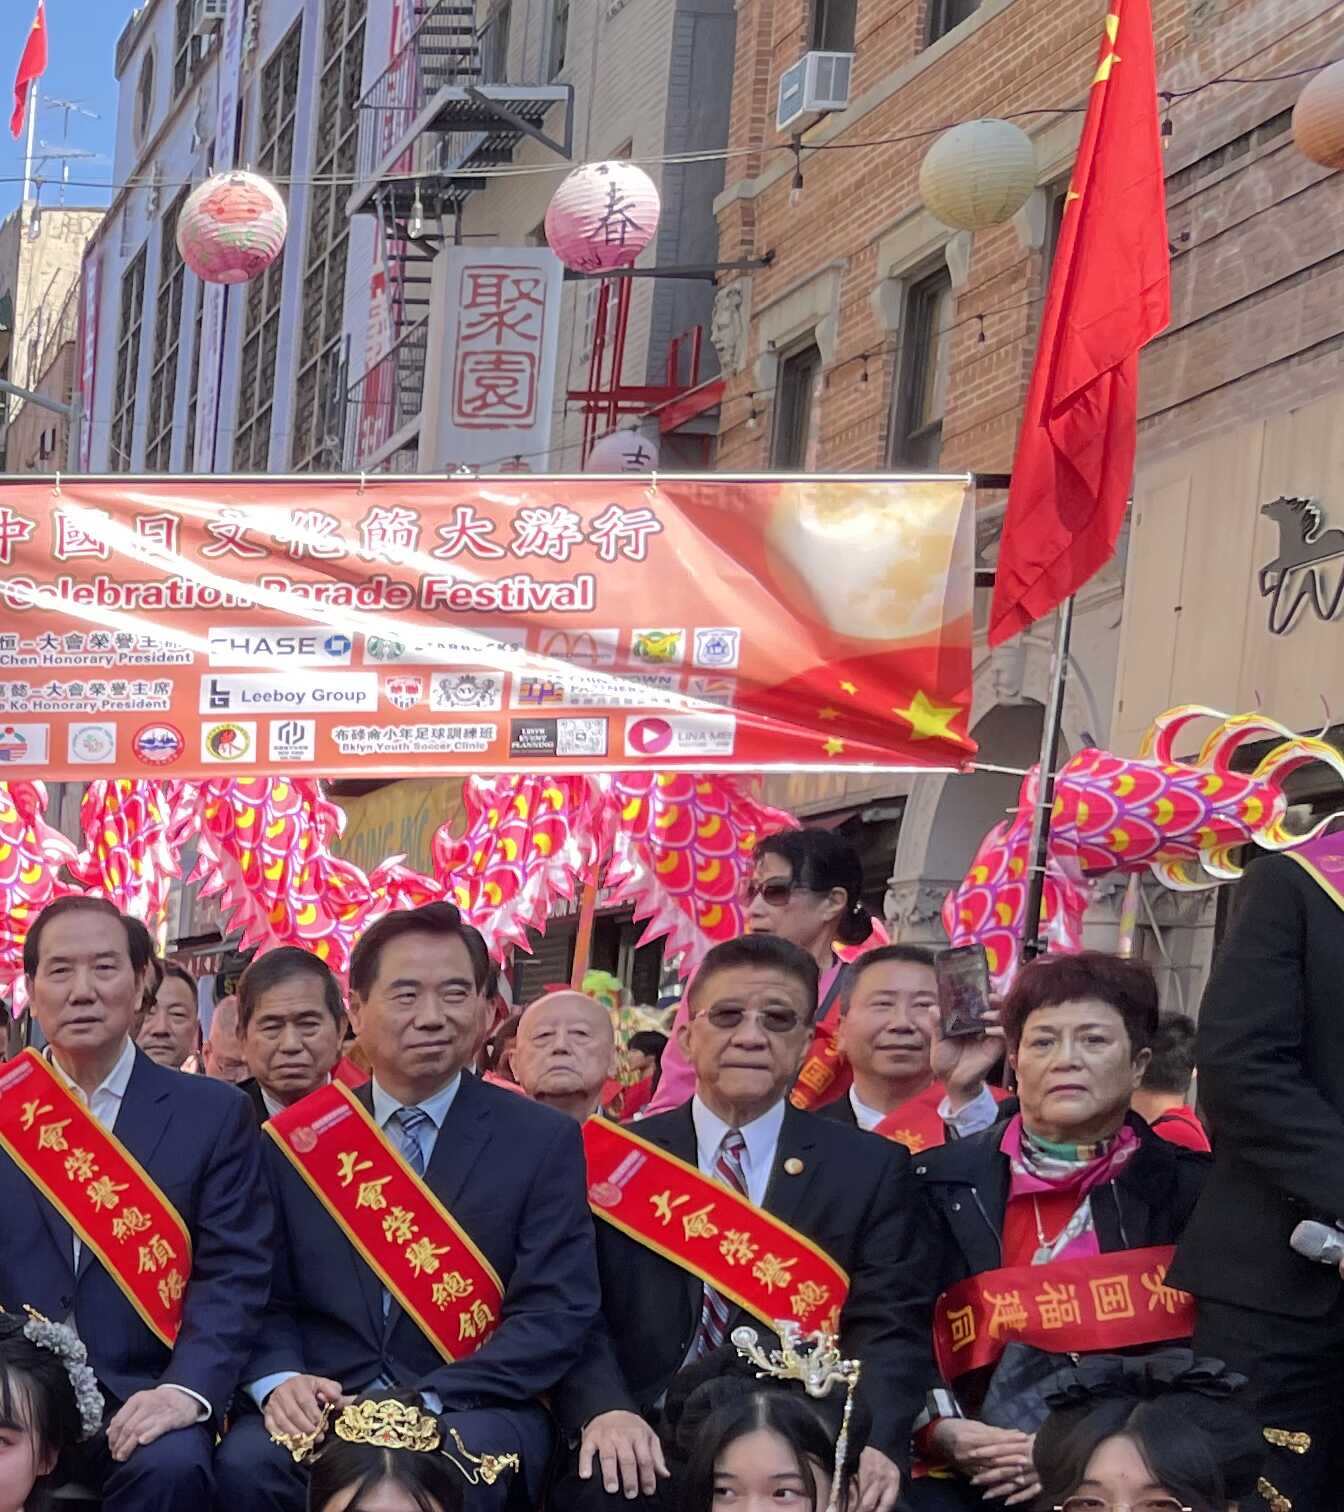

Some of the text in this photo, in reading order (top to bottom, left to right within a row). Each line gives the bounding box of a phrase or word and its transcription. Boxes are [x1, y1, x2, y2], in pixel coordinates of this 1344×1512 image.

[587, 181, 643, 248] 春
[426, 575, 594, 610] Festival
[0, 653, 37, 665] Chen
[42, 653, 113, 667] Honorary
[119, 652, 190, 664] President
[10, 700, 30, 711] Ko
[34, 700, 96, 712] Honorary
[101, 699, 168, 710] President
[241, 687, 367, 706] Leeboy Group
[377, 742, 410, 752] Youth
[336, 1151, 497, 1350] 大會榮譽總領
